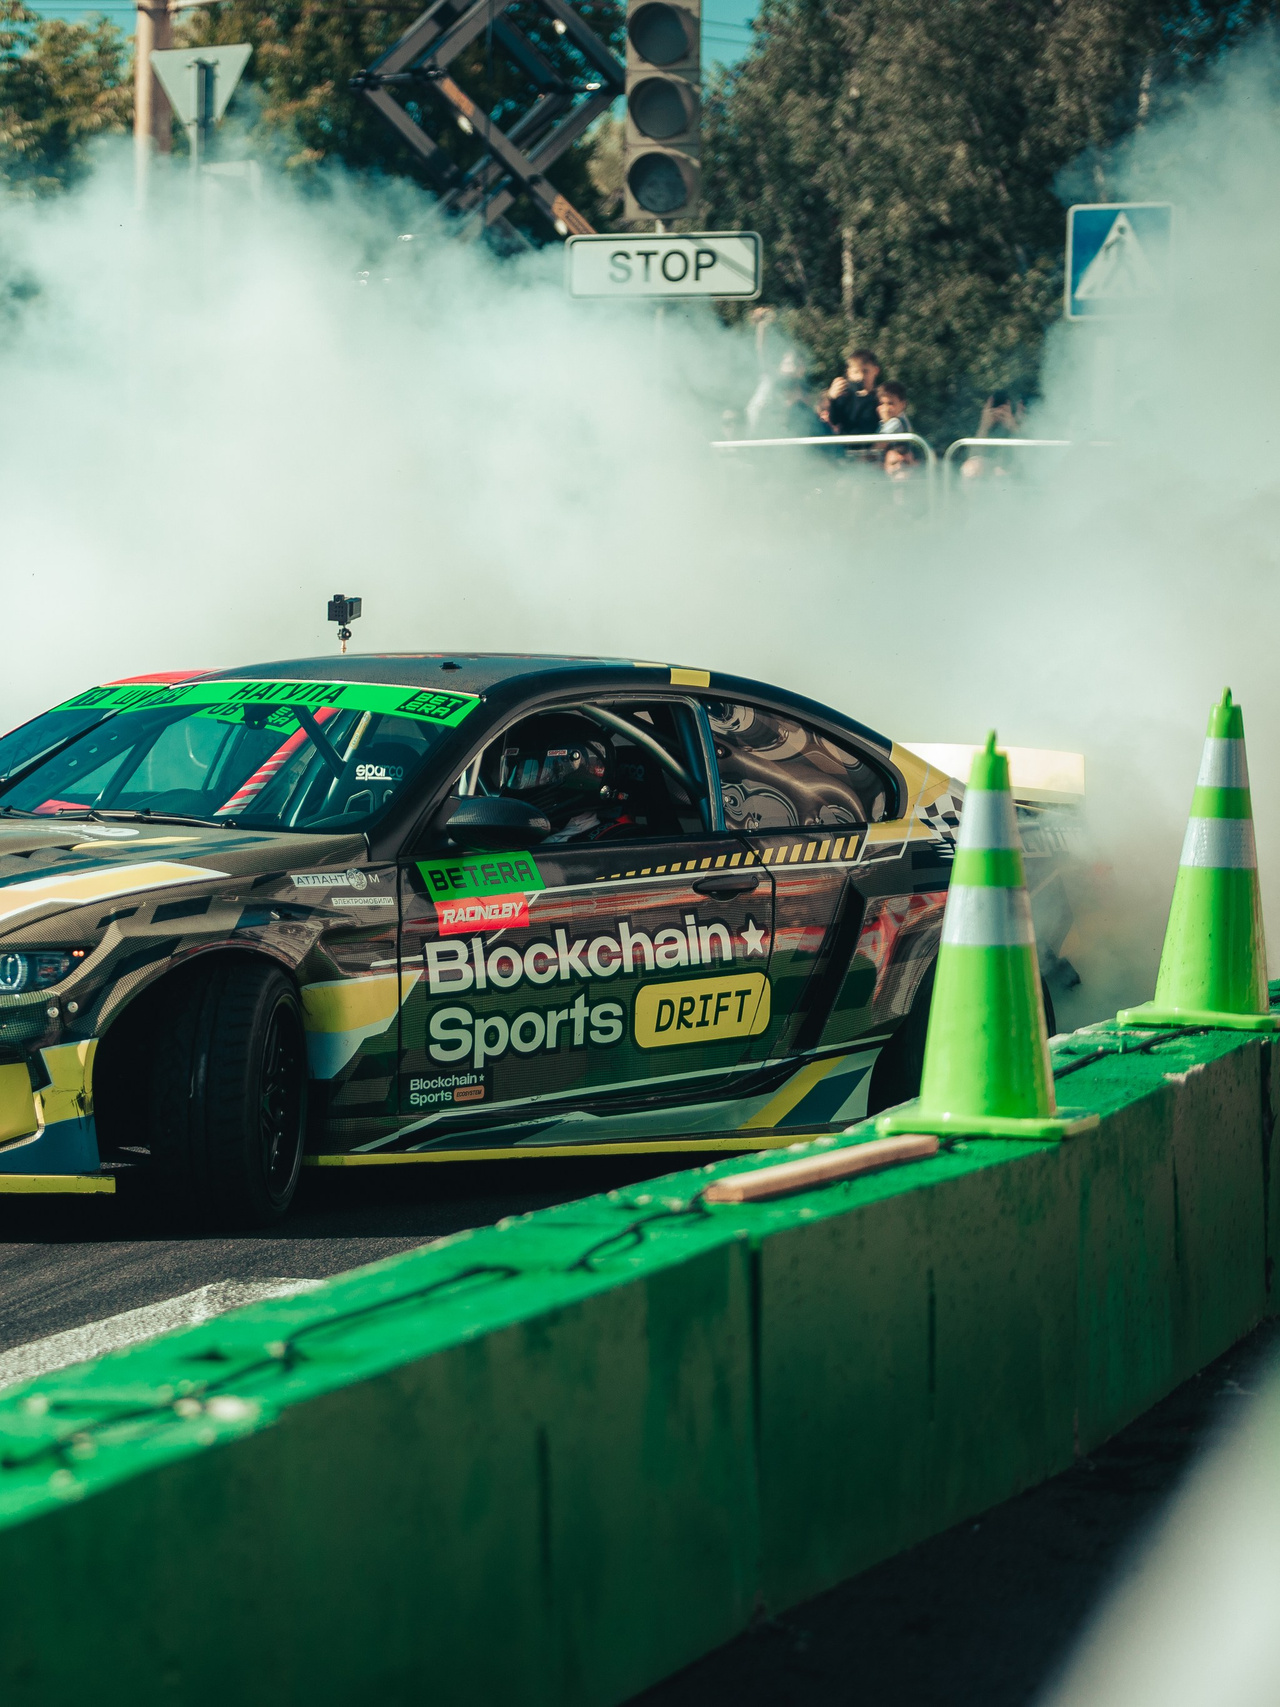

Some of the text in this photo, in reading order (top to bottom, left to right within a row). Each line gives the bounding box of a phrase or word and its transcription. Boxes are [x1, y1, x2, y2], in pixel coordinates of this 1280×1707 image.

[609, 249, 717, 284] STOP
[227, 683, 348, 704] НАГУЛА
[414, 691, 463, 708] BET
[355, 764, 404, 781] sparco
[297, 874, 345, 885] АТЛАНТ
[428, 859, 535, 892] BETERA
[333, 897, 393, 905] ЭЛЕКТРОМОБИЛИ
[424, 914, 733, 995] Blockchain
[428, 988, 753, 1069] Sports DRIFT
[409, 1072, 477, 1091] Blockchain
[409, 1090, 453, 1107] Sports
